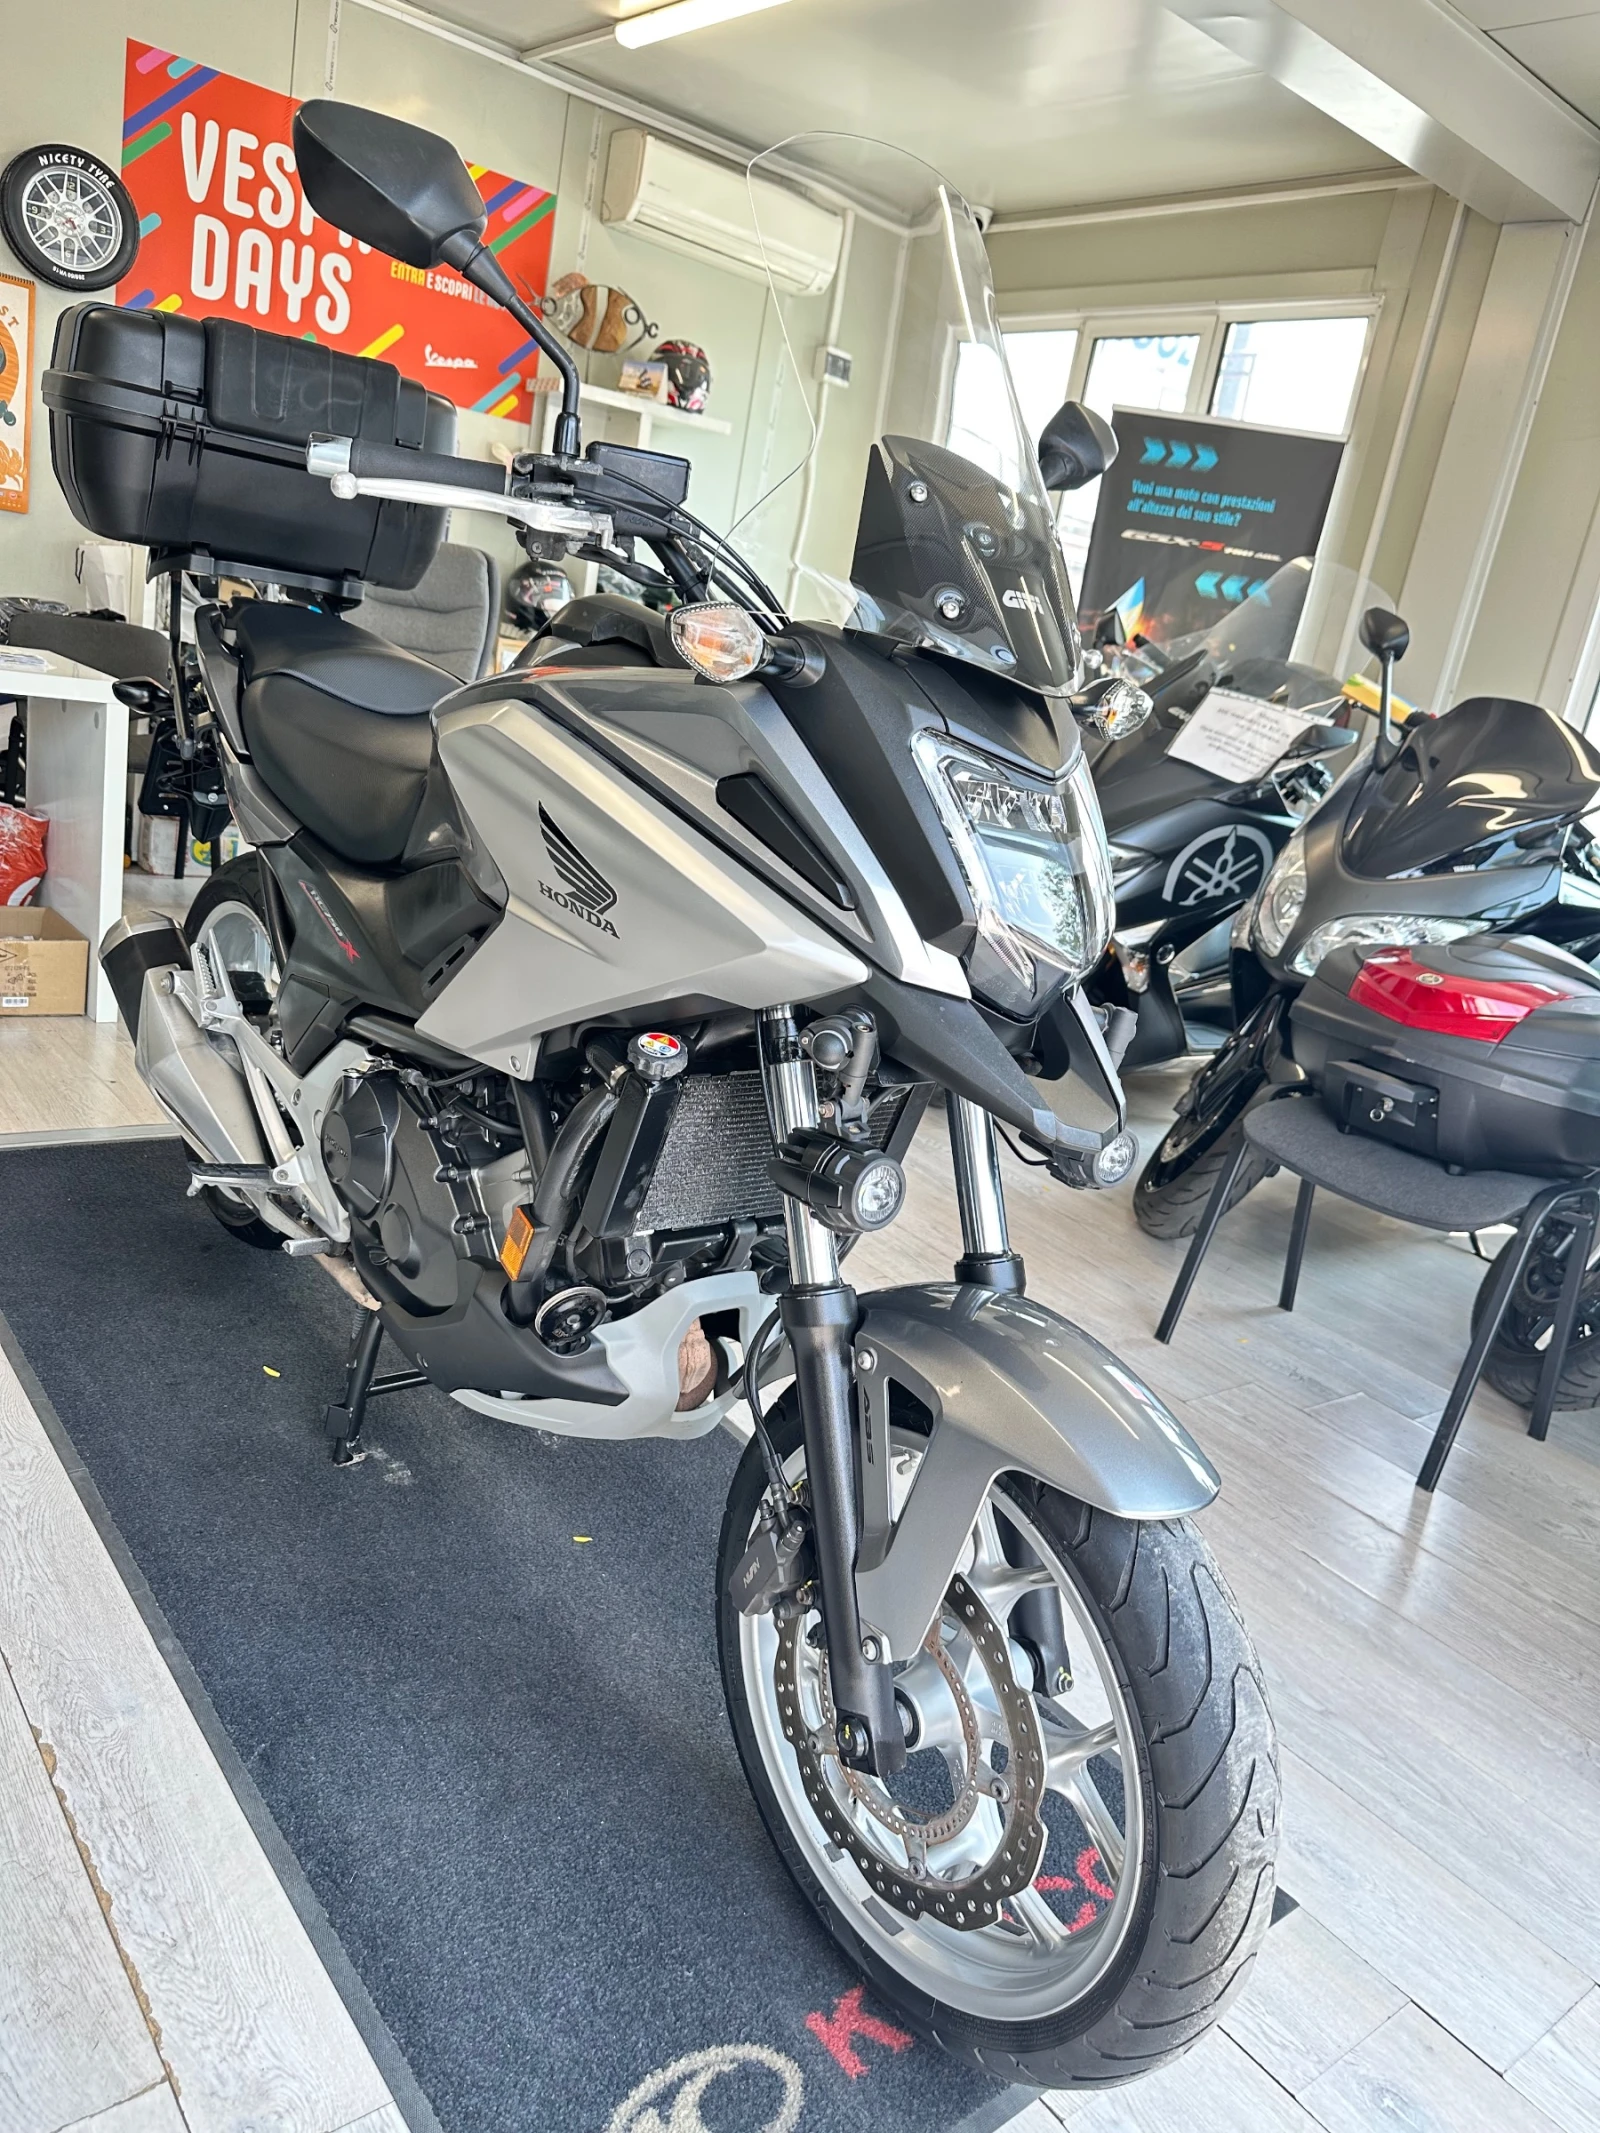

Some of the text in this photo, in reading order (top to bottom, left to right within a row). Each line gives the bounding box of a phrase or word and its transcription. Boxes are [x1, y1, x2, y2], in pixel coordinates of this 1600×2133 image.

[38, 153, 115, 189] NICETY TYRE
[181, 112, 371, 254] VES
[191, 213, 352, 335] DAYS
[390, 260, 426, 287] ENTRA
[426, 271, 434, 290] E
[434, 274, 473, 301] SCOPRI
[424, 343, 478, 369] Vespa
[1132, 478, 1276, 514] Vuoi una moto con prestazioni
[1176, 504, 1193, 520] del
[1193, 509, 1212, 523] suo
[1212, 511, 1242, 527] stile?
[1002, 589, 1044, 615] GIVI
[538, 879, 620, 940] HONDA
